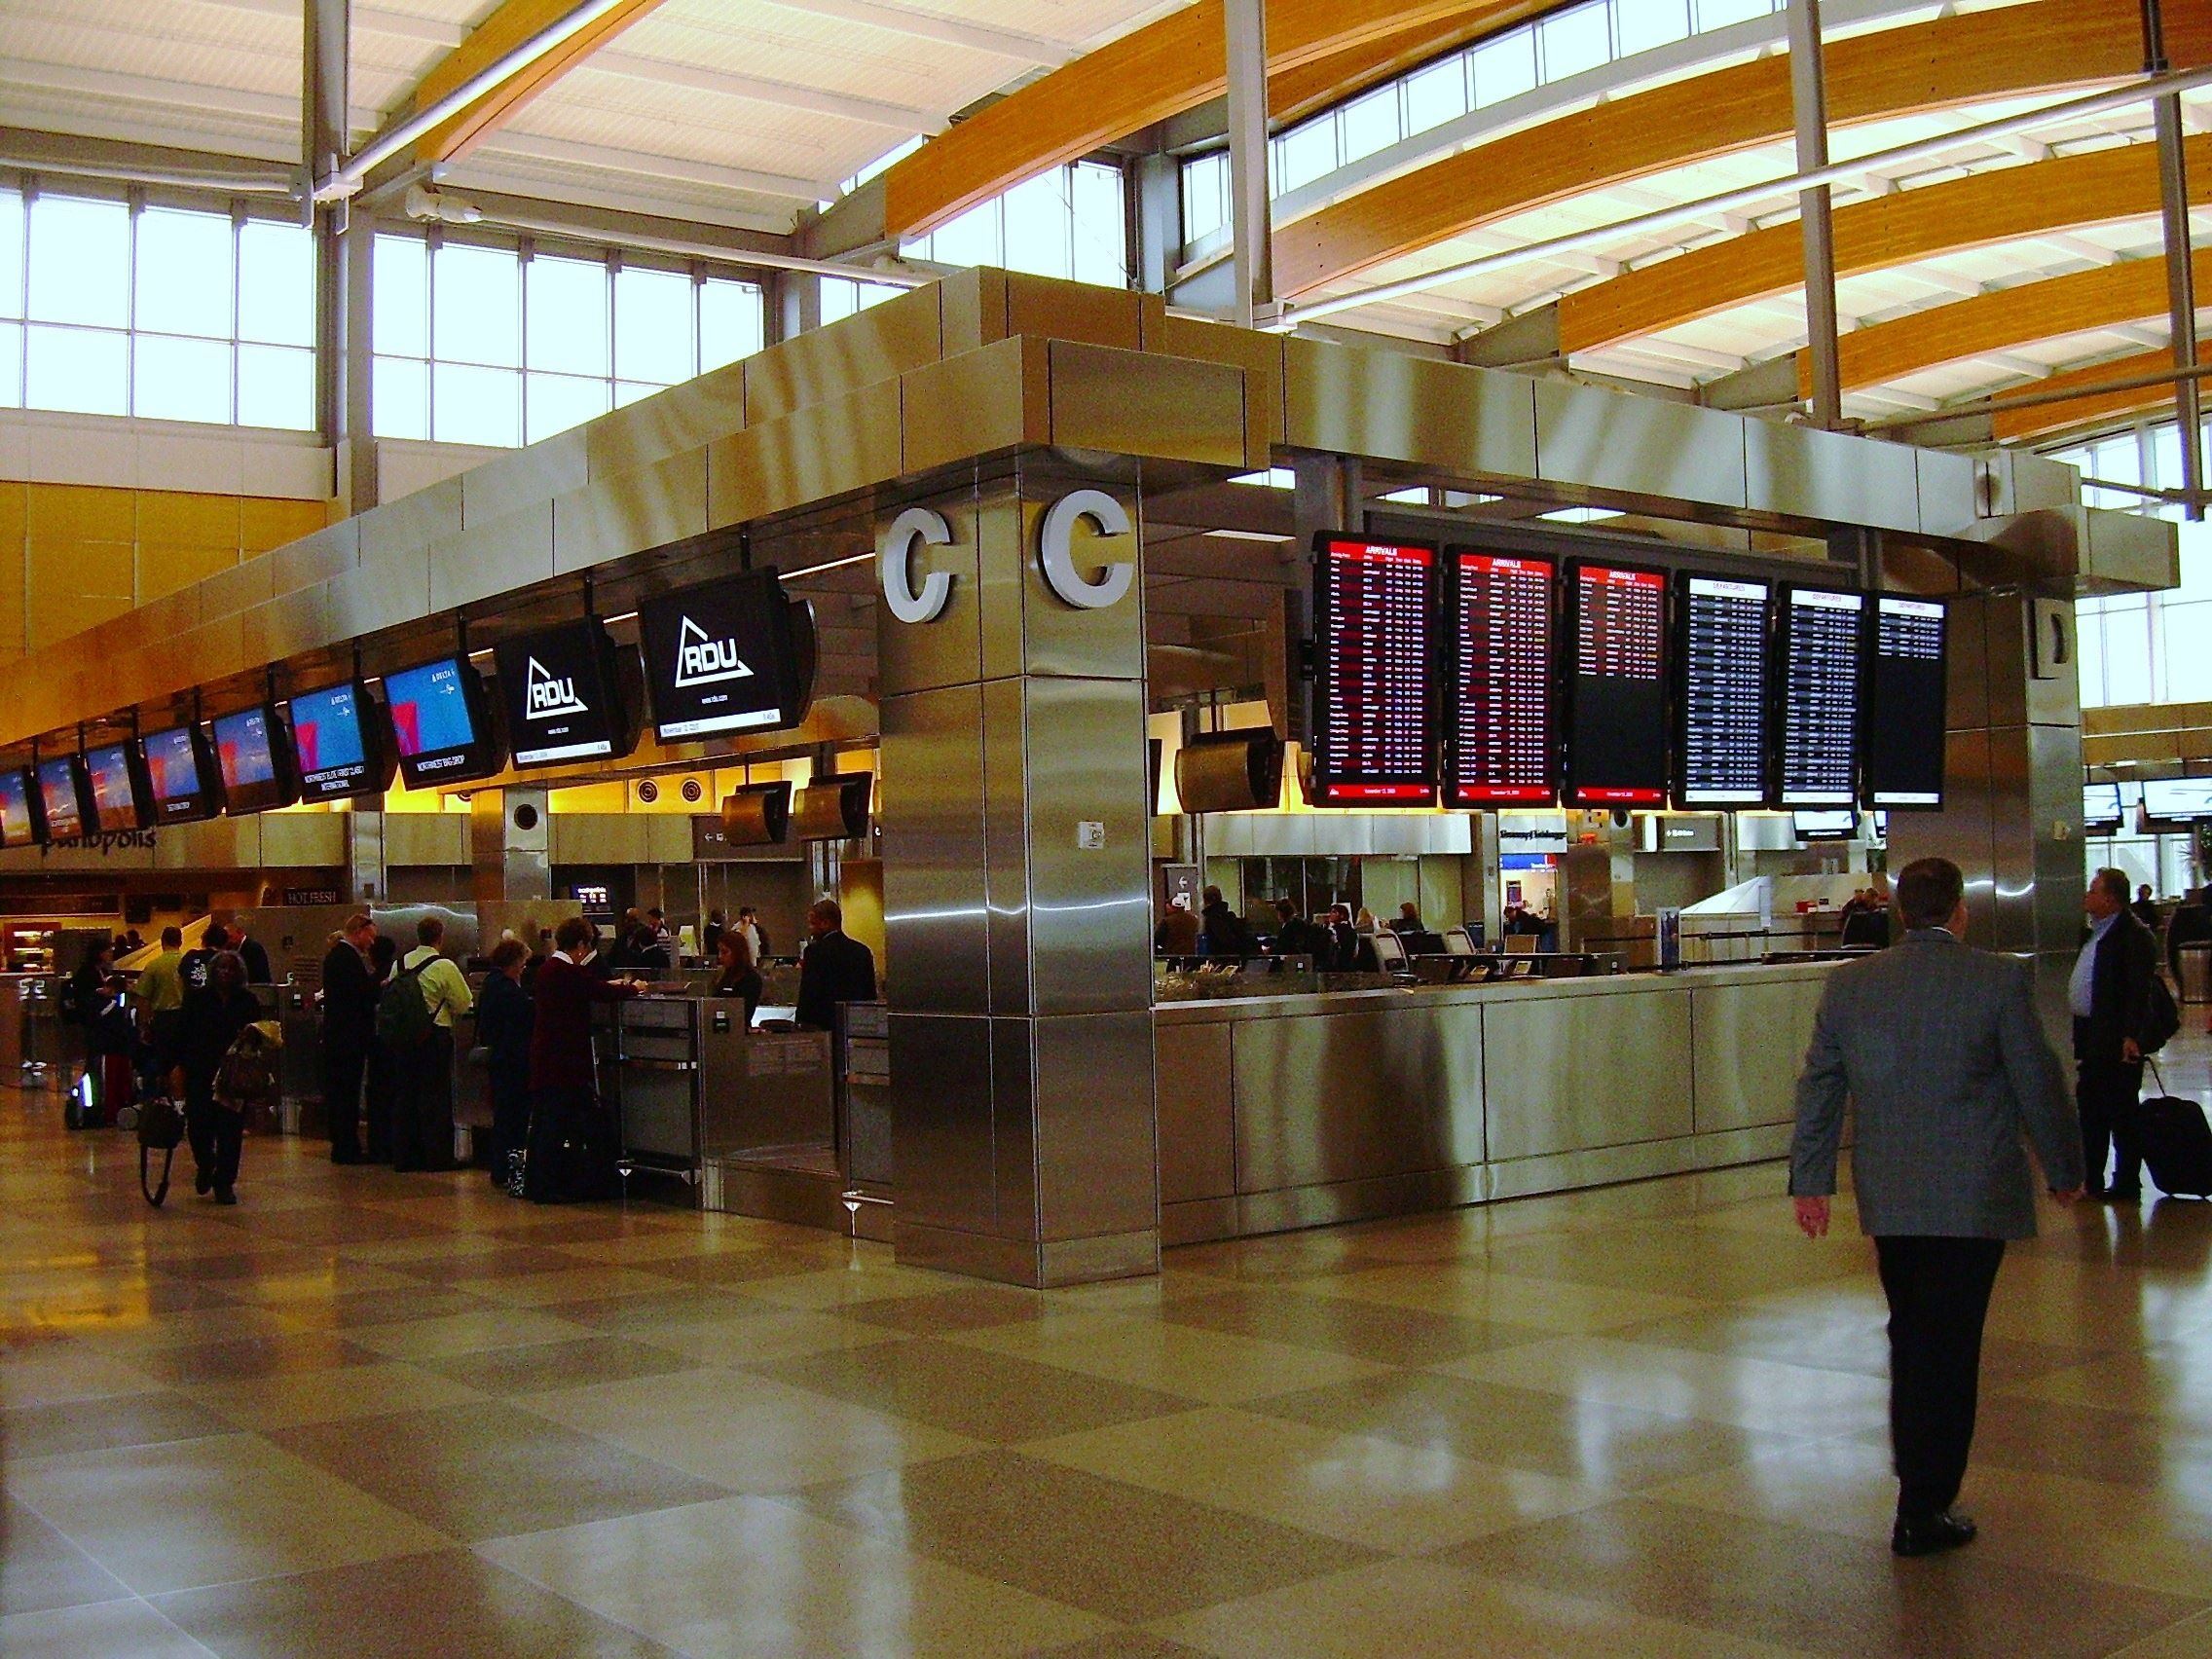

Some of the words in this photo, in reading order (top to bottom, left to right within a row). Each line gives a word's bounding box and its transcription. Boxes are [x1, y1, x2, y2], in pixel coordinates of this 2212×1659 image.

[882, 507, 951, 623] C
[1041, 489, 1134, 609] C
[1365, 545, 1398, 556] ARRIVALS
[1492, 558, 1522, 569] ARRIVALS
[683, 638, 738, 675] RDU
[2028, 597, 2076, 680] D
[532, 677, 575, 709] RDU
